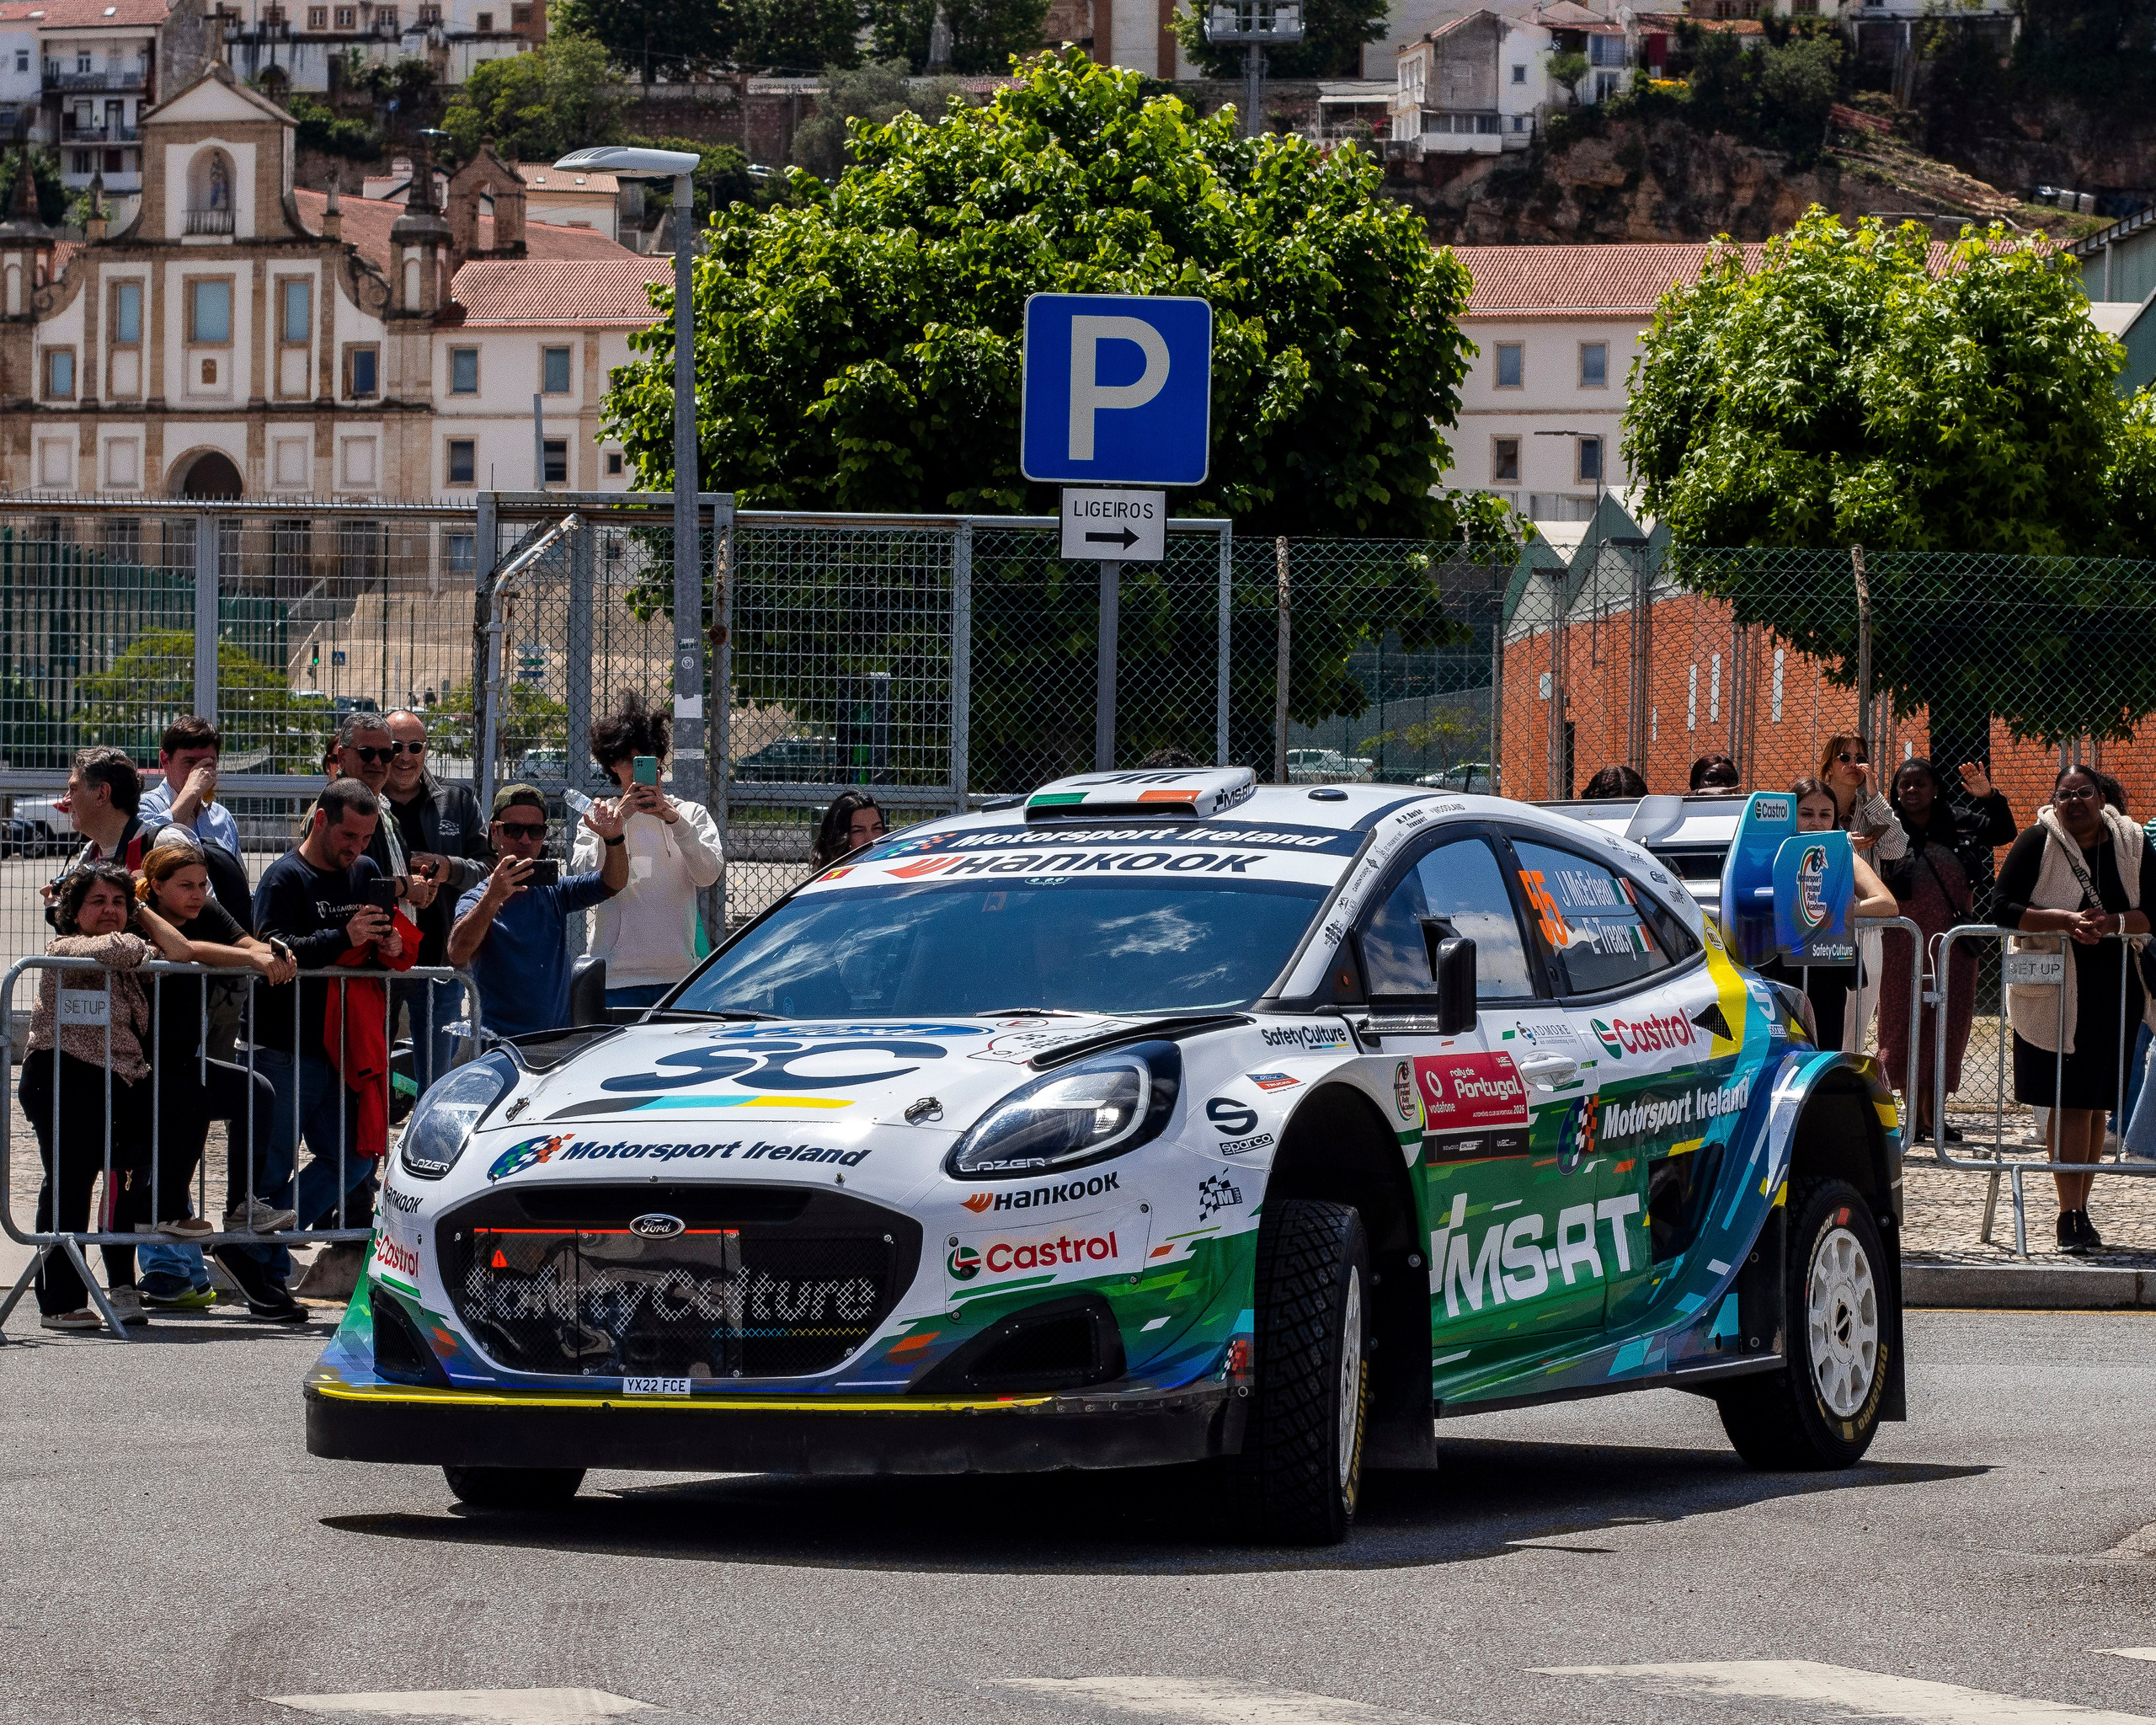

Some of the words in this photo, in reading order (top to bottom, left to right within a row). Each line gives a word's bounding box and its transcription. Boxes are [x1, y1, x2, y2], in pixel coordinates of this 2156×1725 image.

[1069, 314, 1171, 461] P
[1074, 499, 1154, 520] LIGEIROS
[1762, 803, 1788, 819] Castrol
[951, 827, 1179, 849] Motorsport
[1180, 826, 1338, 846] Ireland
[1798, 873, 1822, 884] Motorsport
[1555, 871, 1572, 907] J
[1561, 871, 1618, 907] McErlean
[1805, 884, 1821, 893] Ireland
[1806, 894, 1818, 902] Rally
[1518, 870, 1569, 947] 55
[1806, 903, 1827, 913] Academy
[1582, 917, 1601, 954] E
[1592, 917, 1637, 961] Treacy
[1812, 944, 1854, 959] SafetyCulture
[2009, 963, 2036, 975] SET
[2041, 964, 2060, 975] UP
[64, 999, 106, 1015] SETUP
[1262, 1024, 1347, 1049] SafetyCulture
[1613, 1007, 1697, 1055] Castrol
[1449, 1067, 1466, 1078] rally
[1465, 1067, 1475, 1076] de
[1264, 1079, 1292, 1087] TRUCKS
[1454, 1075, 1523, 1101] Portugal
[1429, 1102, 1456, 1114] vodafone
[1513, 1104, 1525, 1115] 2026
[1603, 1090, 1691, 1140] Motorsport
[1696, 1076, 1749, 1120] Ireland
[1221, 1134, 1271, 1154] sparco
[558, 1140, 745, 1164] Motorsport
[743, 1140, 873, 1167] Ireland
[410, 1156, 451, 1172] LAZER
[958, 1156, 1046, 1173] LAZER
[640, 1218, 672, 1234] Ford
[376, 1235, 419, 1279] Castrol
[987, 1230, 1119, 1274] Castrol
[1444, 1193, 1641, 1318] MS-RT
[627, 1379, 658, 1391] YX22
[662, 1380, 686, 1392] FCE
